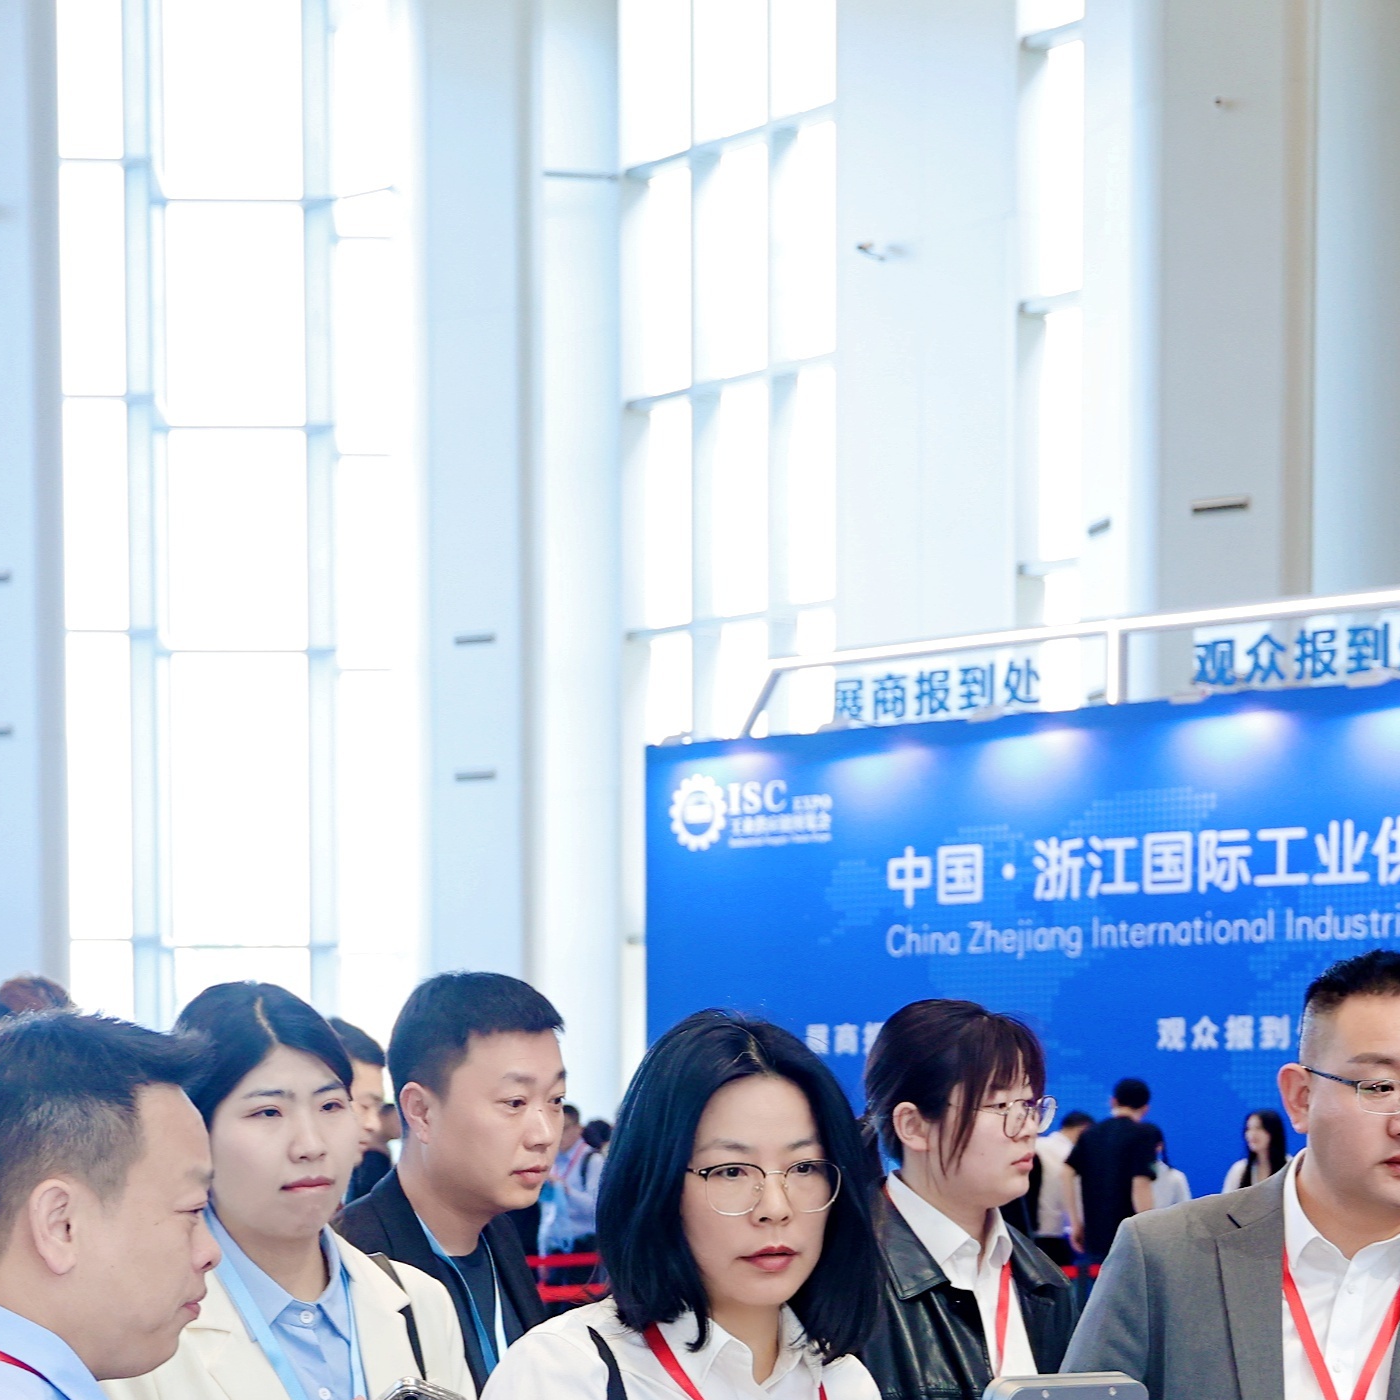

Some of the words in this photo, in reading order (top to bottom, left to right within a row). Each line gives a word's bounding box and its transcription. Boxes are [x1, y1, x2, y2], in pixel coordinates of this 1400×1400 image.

[835, 658, 1040, 720] 展商报到处
[727, 779, 788, 816] ISC
[886, 922, 960, 958] China
[967, 918, 1083, 959] Zhejiang
[1091, 908, 1276, 949] International
[1157, 1014, 1300, 1052] 观众报到
